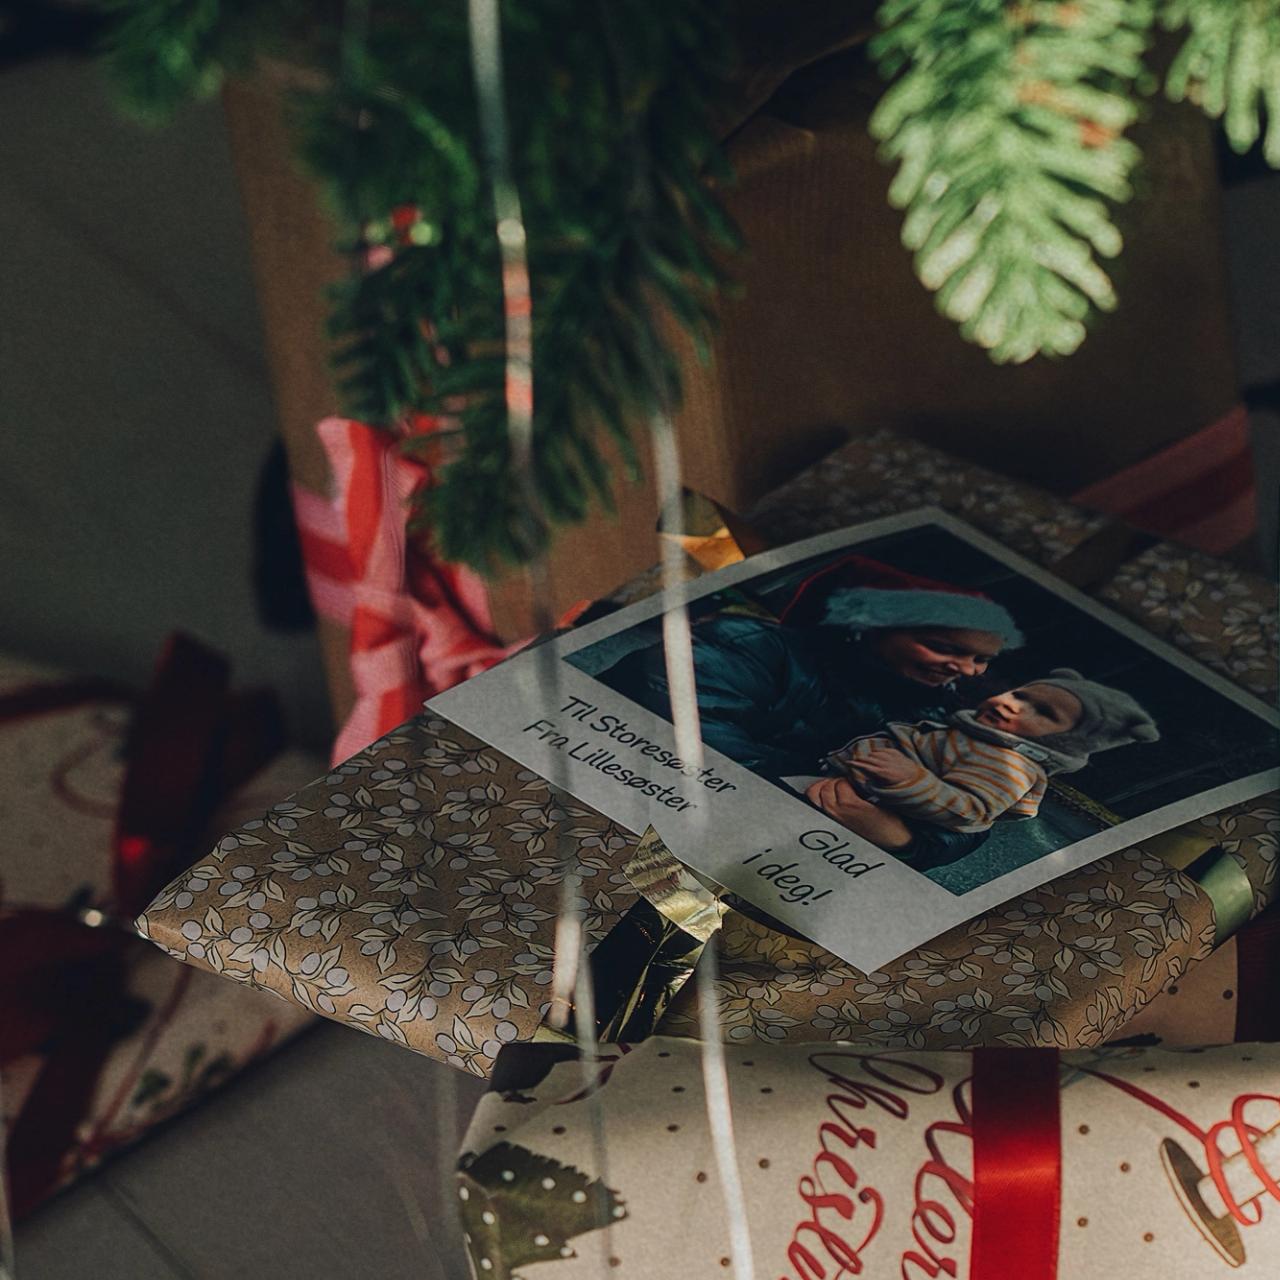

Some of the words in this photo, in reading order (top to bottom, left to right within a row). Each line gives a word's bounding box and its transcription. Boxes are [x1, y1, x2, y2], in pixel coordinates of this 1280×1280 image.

[560, 695, 598, 722] Til
[522, 719, 569, 750] Fra
[568, 742, 698, 814] Lillesøster
[742, 848, 772, 866] i
[759, 862, 833, 906] deg!
[798, 829, 885, 879] Glad
